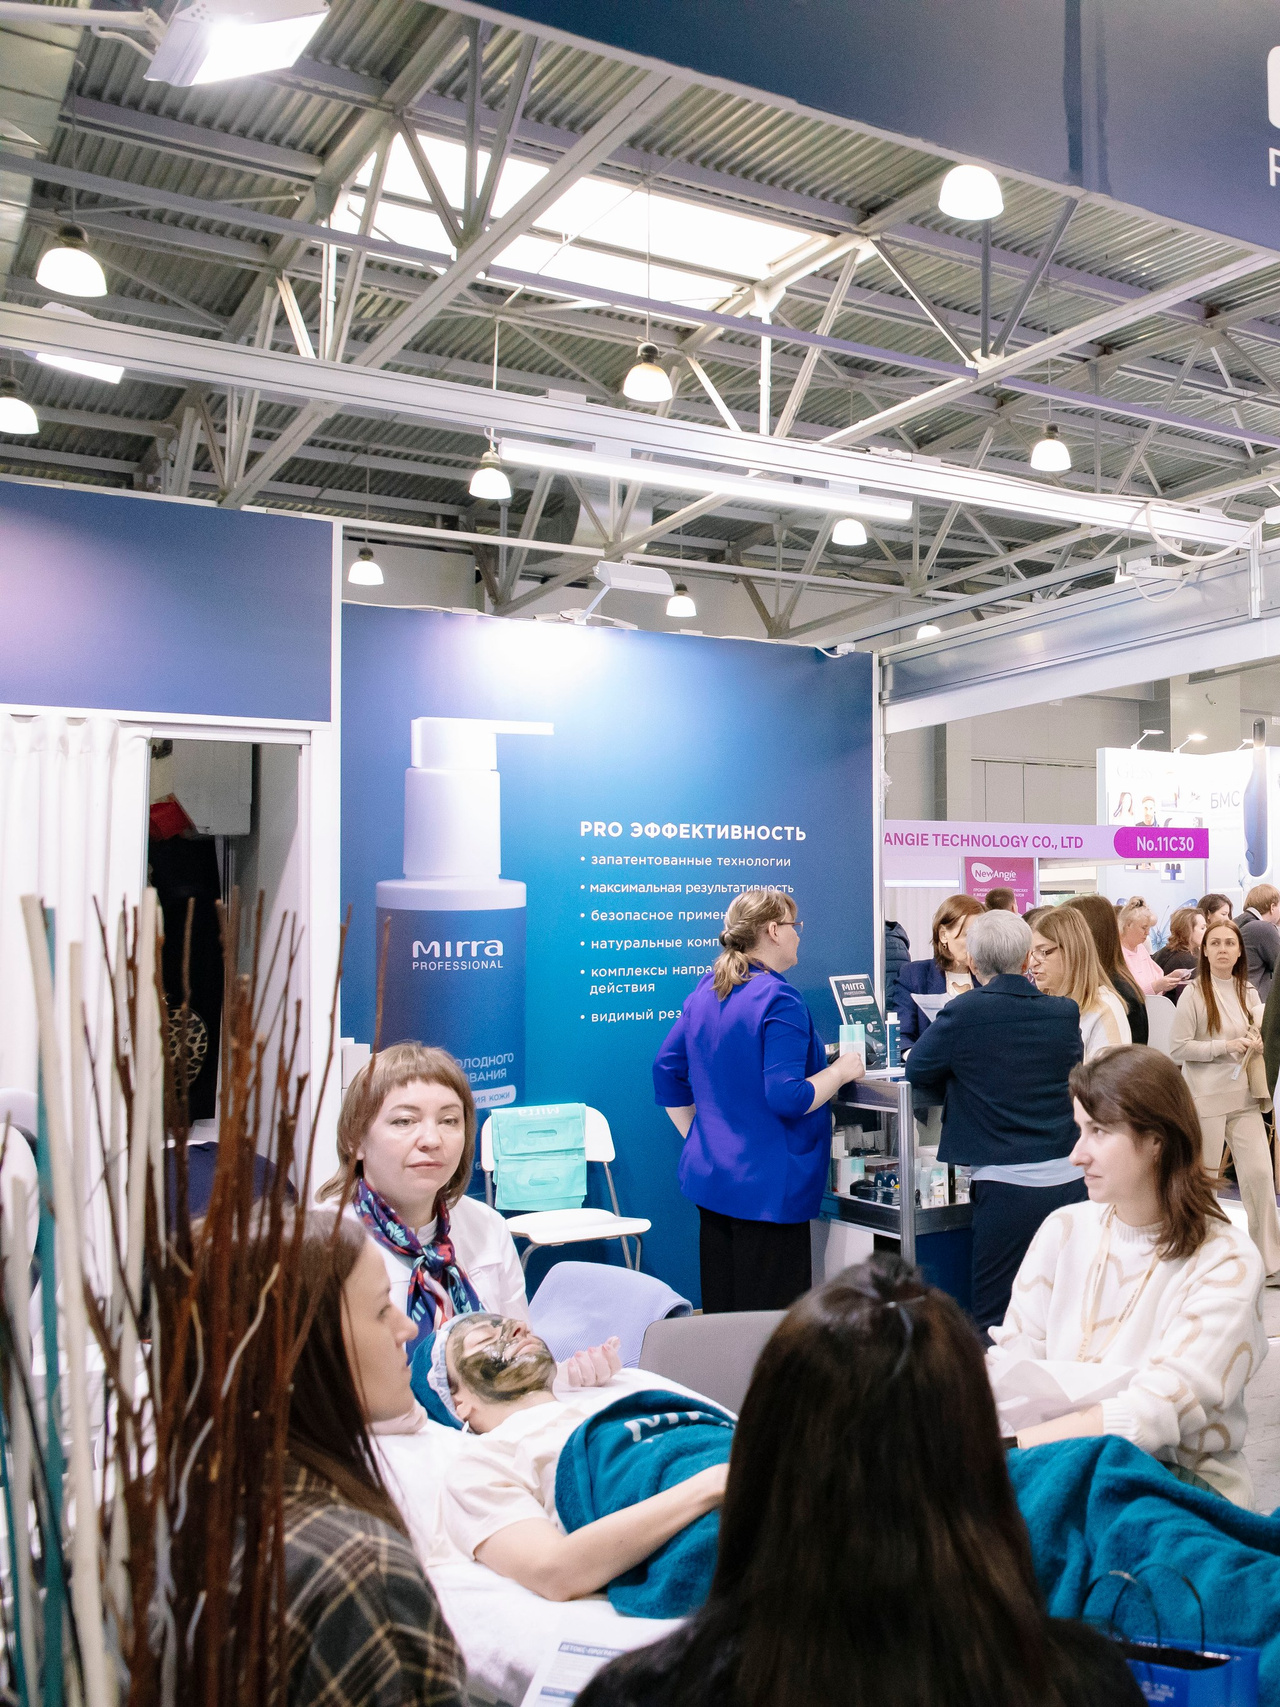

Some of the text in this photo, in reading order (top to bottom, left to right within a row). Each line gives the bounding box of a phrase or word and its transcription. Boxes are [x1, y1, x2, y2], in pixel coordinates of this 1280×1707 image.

[1210, 790, 1241, 810] БМС
[580, 821, 807, 841] PRO ЭФФЕКТИВНОСТЬ
[884, 833, 1083, 850] ANGIE TECHNOLOGY CO., LTD
[1136, 836, 1195, 851] No.11C30
[591, 855, 791, 867] запатентованные технологии
[975, 869, 1017, 882] NewAngie
[590, 883, 794, 895] максимальная результативность
[591, 910, 674, 922] безопасное
[591, 938, 720, 950] натуральные комп
[412, 960, 503, 971] PROFESSIONAL
[591, 965, 712, 977] комплексы напра
[589, 982, 655, 995] действия
[591, 1009, 654, 1022] видимый
